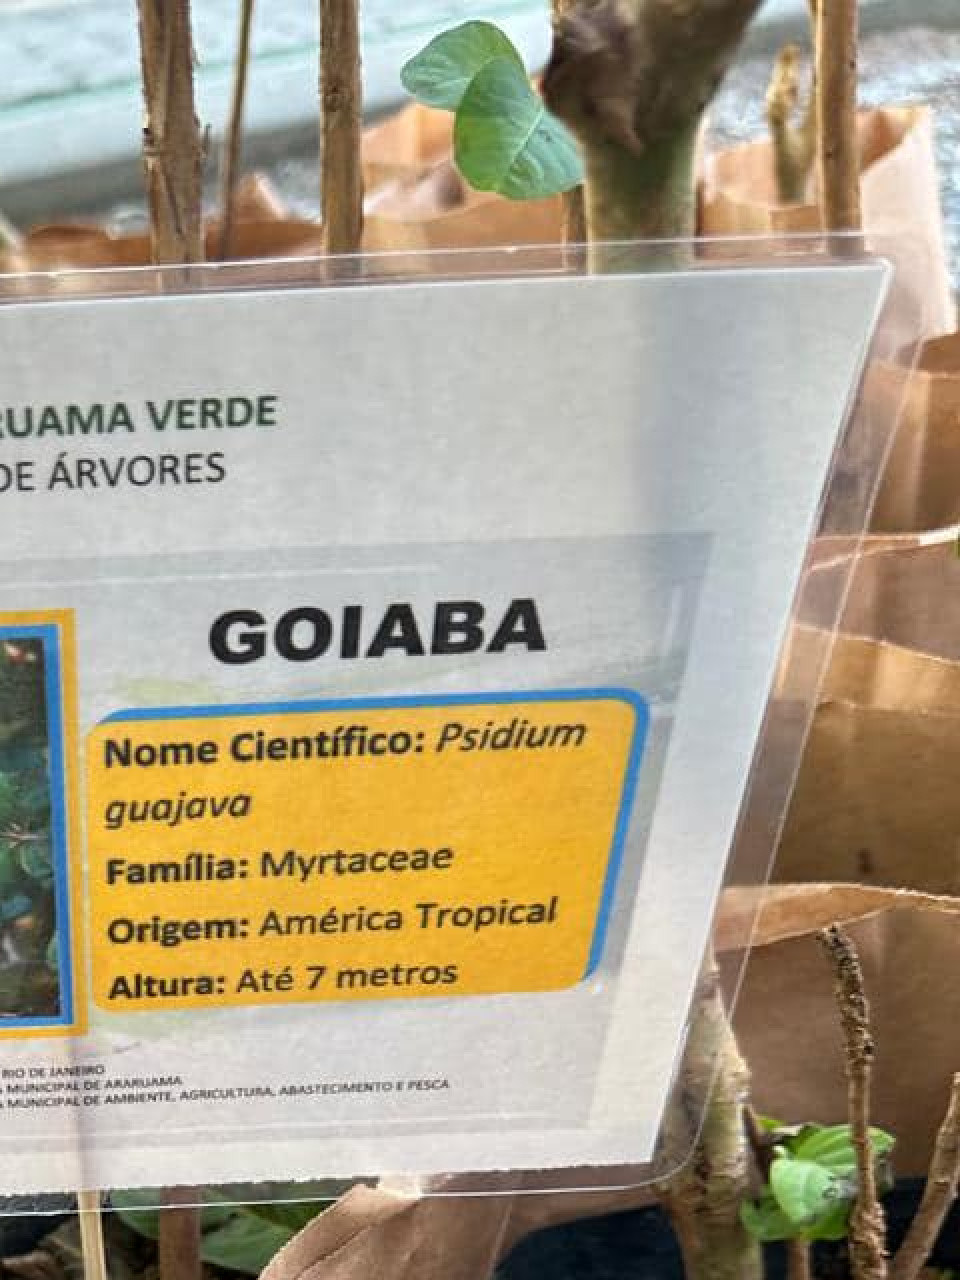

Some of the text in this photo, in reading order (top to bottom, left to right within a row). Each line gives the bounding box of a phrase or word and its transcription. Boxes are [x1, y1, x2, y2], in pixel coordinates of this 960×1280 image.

[144, 395, 279, 430] VERDE
[48, 451, 227, 490] ÁRVORES
[208, 597, 547, 666] GOIABA
[103, 720, 587, 769] Nome Científico: Psidium
[104, 791, 252, 829] guajava
[105, 846, 455, 886] Família: Myrtaceae
[106, 895, 559, 949] Origem: América Tropical
[107, 963, 459, 1002] Altura: Até 7 metros
[1, 1068, 25, 1080] RIO
[28, 1067, 46, 1079] DE
[49, 1064, 105, 1078] JANEIRO
[7, 1081, 81, 1096] MUNICIPAL
[83, 1080, 100, 1092] DE
[104, 1075, 183, 1090] ARARUAMA
[7, 1096, 81, 1108] MUNICIPAL
[83, 1094, 100, 1107] DE
[396, 1081, 405, 1092] E
[407, 1078, 450, 1092] PESCA
